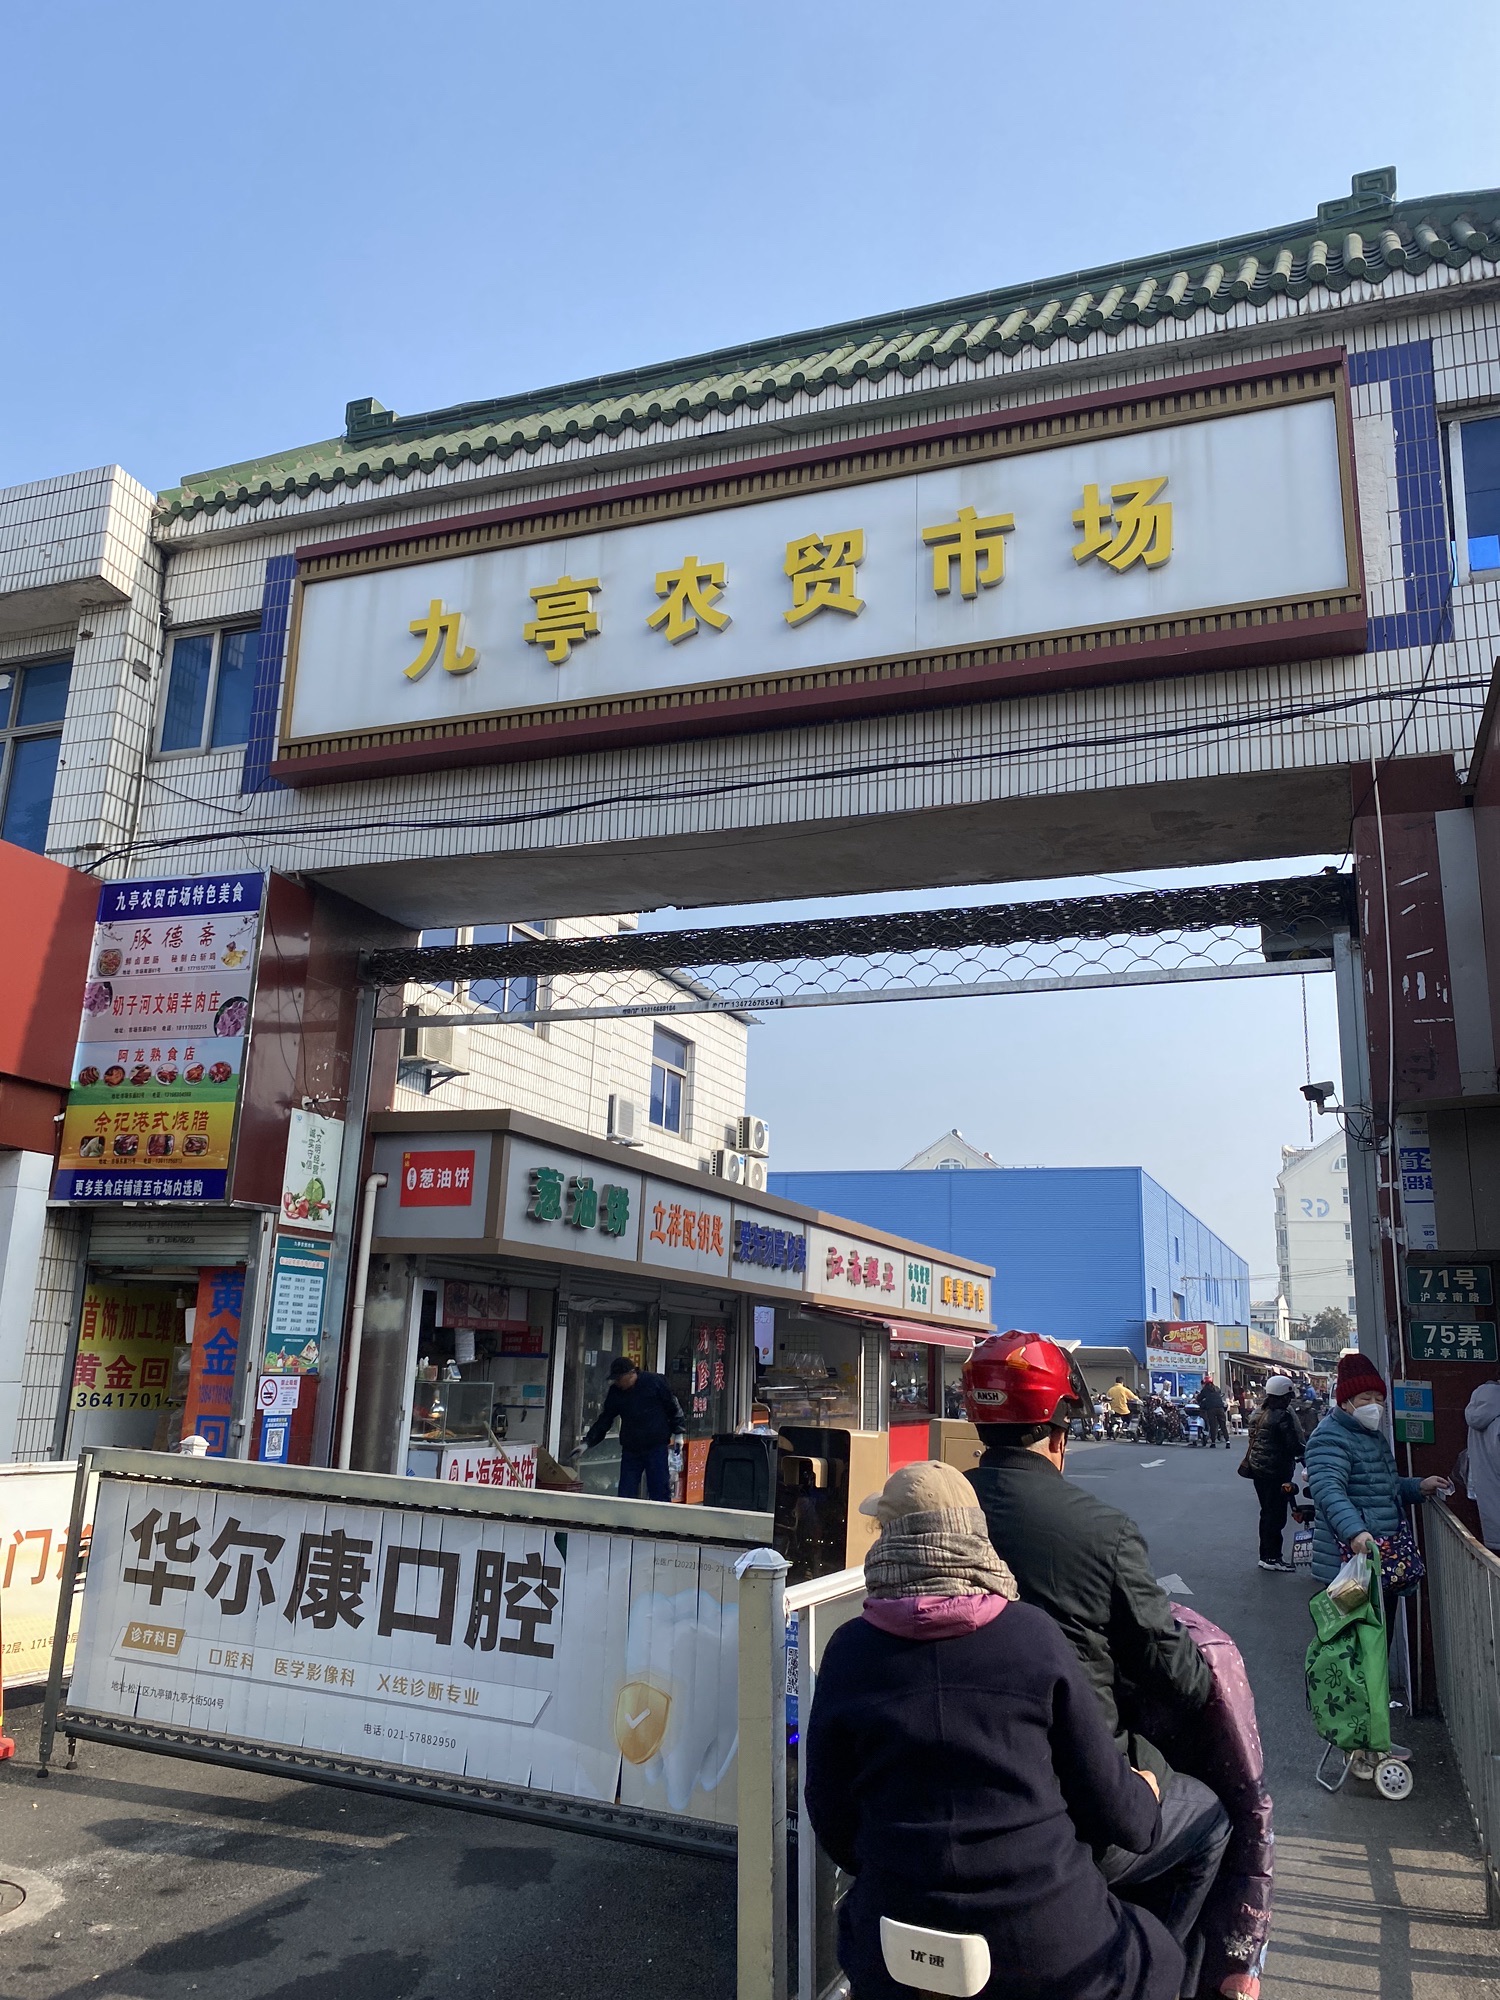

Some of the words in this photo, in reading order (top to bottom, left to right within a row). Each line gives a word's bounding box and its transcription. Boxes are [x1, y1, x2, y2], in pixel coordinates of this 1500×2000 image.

[402, 476, 1174, 682] 九亭农贸市场
[115, 882, 244, 911] 九亭农贸市场特色美食
[129, 922, 216, 950] 豚德斋
[171, 952, 217, 963] 秘制白斩鸡
[112, 991, 221, 1017] 奶子河文娟羊肉庄
[118, 1046, 195, 1062] 阿龙熟食店
[94, 1111, 209, 1133] 余记港式烧腊
[74, 1179, 203, 1196] 更多美食店铺请至市场内选购
[419, 1167, 470, 1188] 葱油饼
[532, 1166, 629, 1236] 葱油饼
[650, 1200, 724, 1257] 立祥配钥匙
[1419, 1269, 1478, 1290] 71号
[1420, 1292, 1480, 1303] 沪亭南路
[1423, 1325, 1483, 1347] 75弄
[1424, 1348, 1484, 1359] 沪亭南路
[977, 1391, 999, 1401] ANSH
[123, 1506, 562, 1661] 华尔康口腔
[130, 1626, 178, 1649] 诊疗科目
[208, 1648, 255, 1671] 口腔科
[274, 1657, 356, 1687] 医学影像科
[376, 1673, 480, 1707] X线诊断专业
[910, 1949, 945, 1968] 优速
